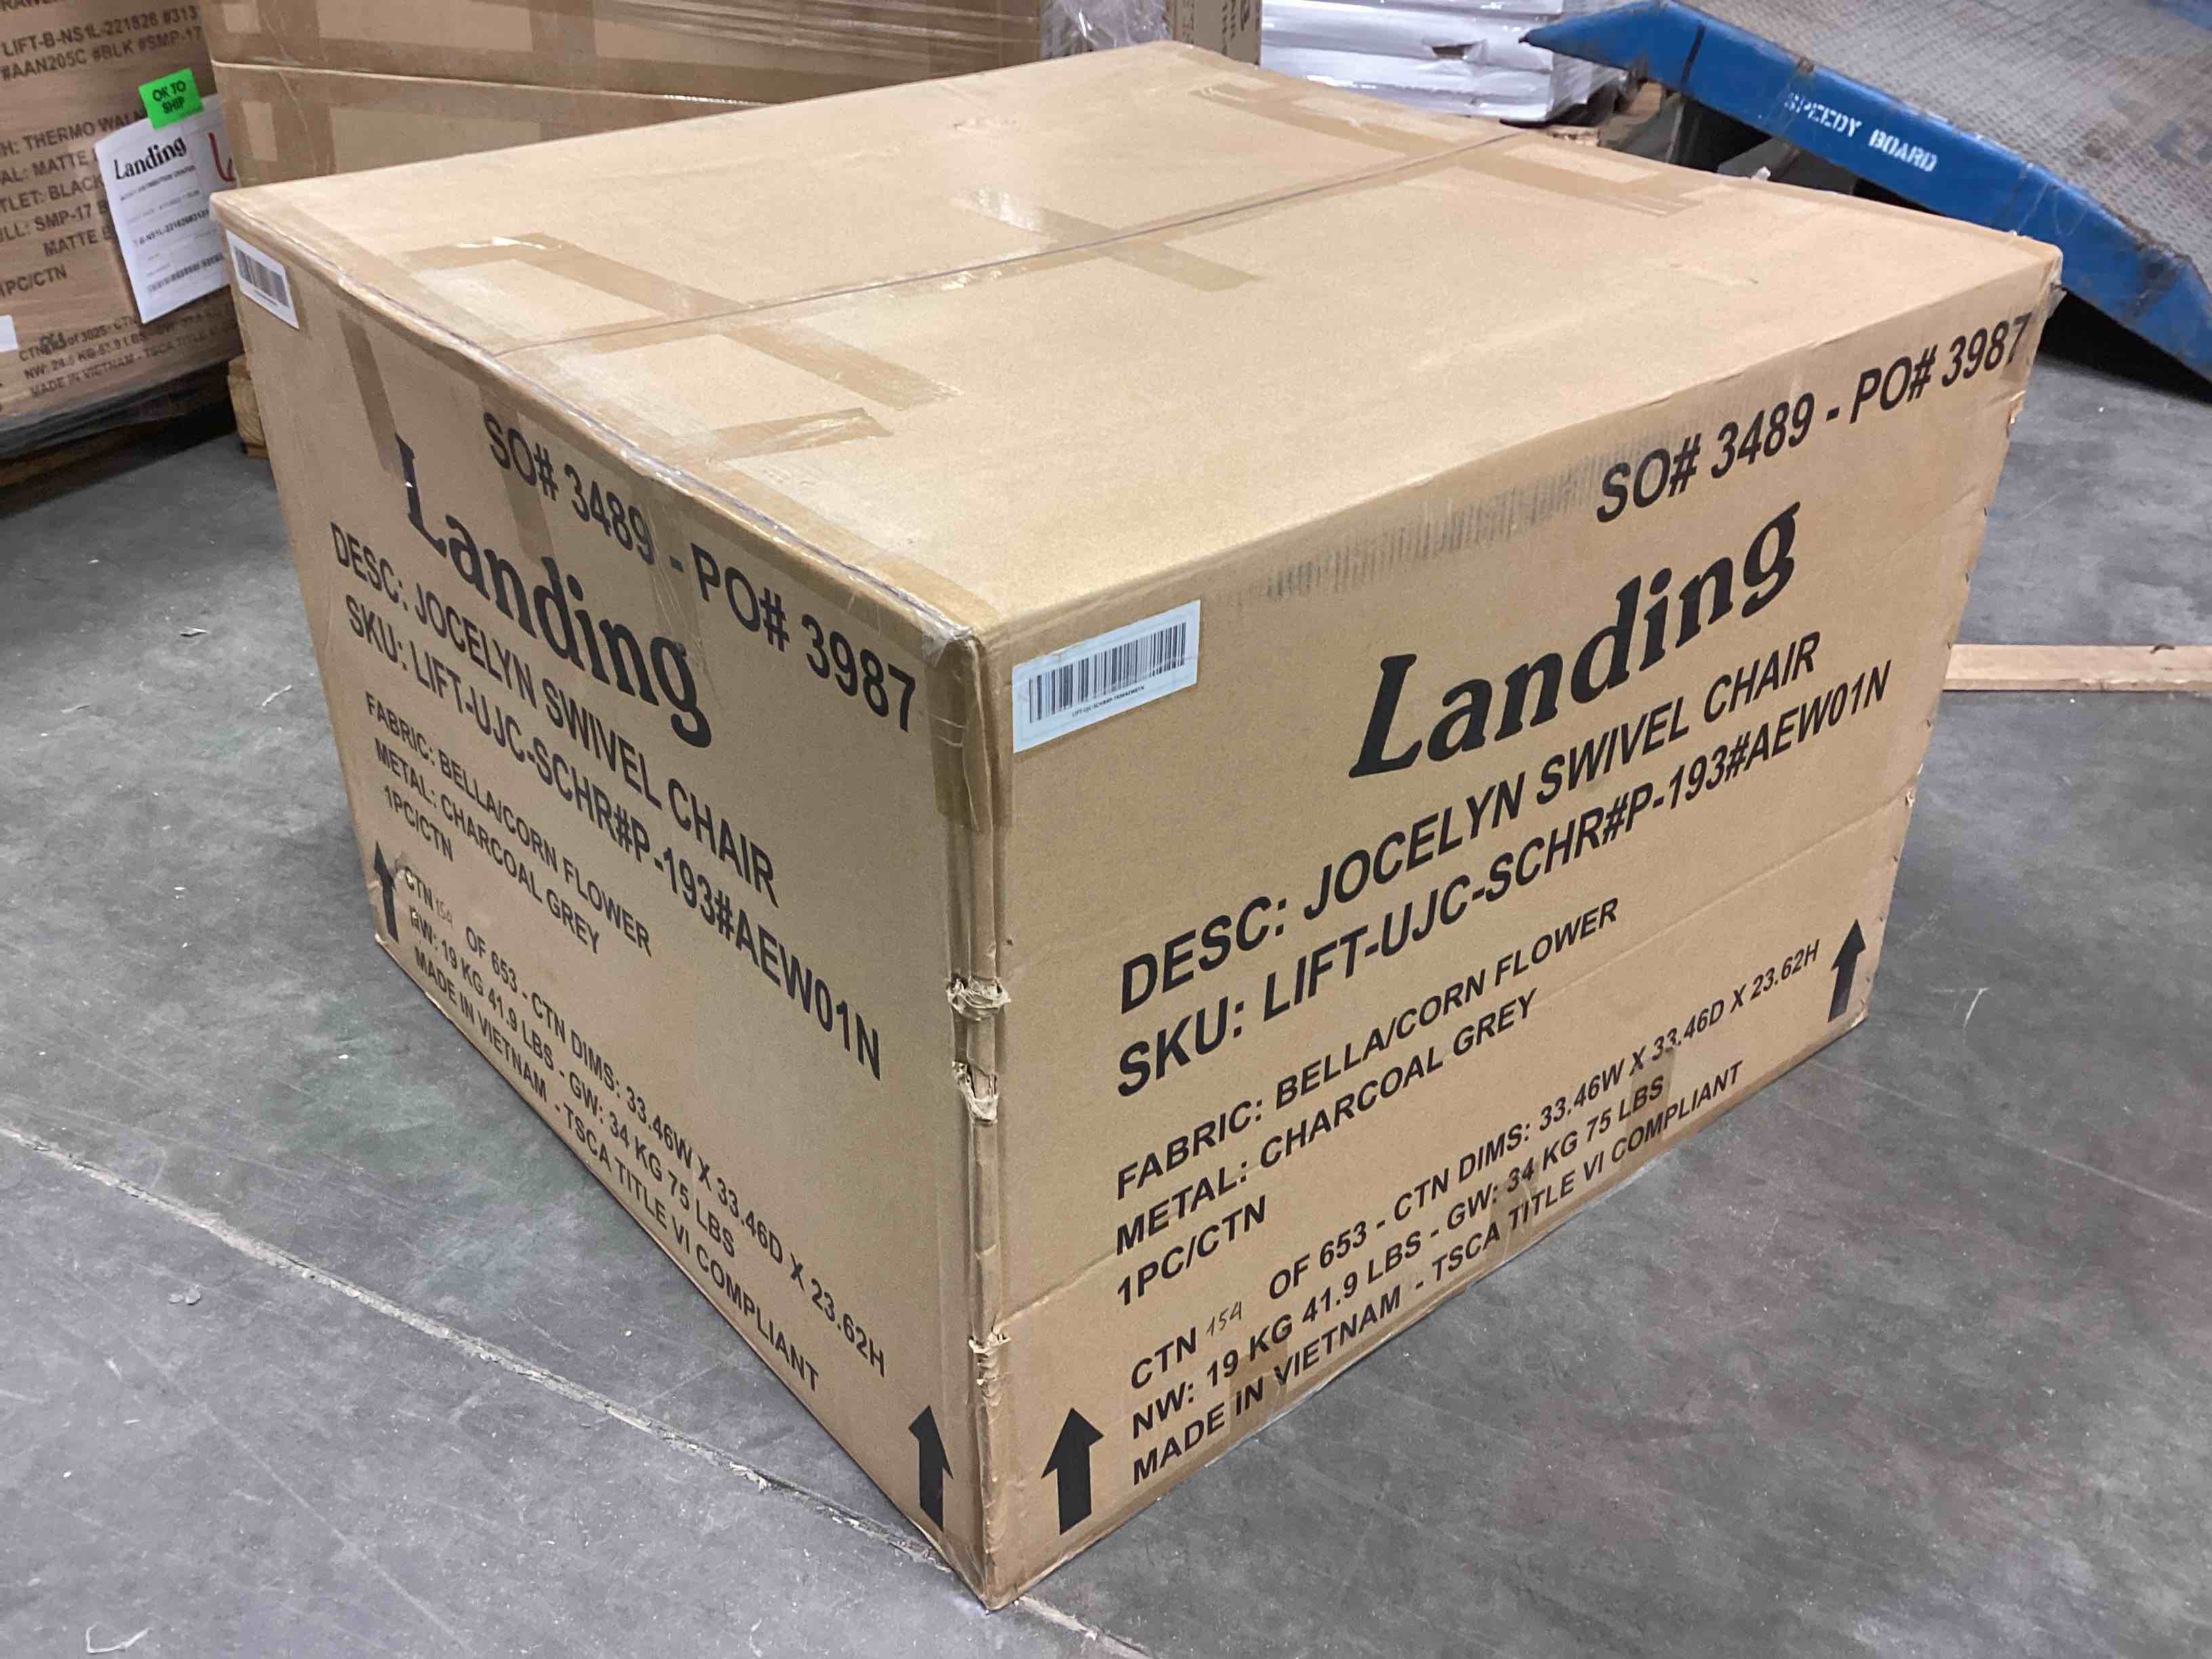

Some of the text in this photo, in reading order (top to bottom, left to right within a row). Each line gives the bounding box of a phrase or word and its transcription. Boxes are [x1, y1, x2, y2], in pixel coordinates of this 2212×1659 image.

[22, 121, 96, 150] THERMO
[33, 150, 89, 176] MATTE
[35, 203, 92, 231] SMP-17
[113, 136, 187, 180] Landing
[152, 79, 187, 102] OK TO
[162, 96, 186, 115] SHIP
[1784, 91, 1938, 172] SPEEDY BOARD
[43, 228, 98, 256] MATTE
[1597, 432, 1702, 523] SO#
[1711, 392, 1815, 479] 3489
[1849, 344, 1938, 424] PO#
[1941, 312, 2032, 388] 3987
[394, 432, 712, 748] Landing
[483, 411, 559, 501] SO#
[564, 464, 655, 565] 3489
[690, 542, 790, 653] PO#
[801, 614, 916, 733] 3987
[1348, 501, 1801, 779] Landing
[330, 521, 779, 909] DESC: JOCELYN SWIVEL CHAIR
[346, 594, 880, 1082] SKU: LIFT-UJC-SCHR#P-193#AEW01N
[365, 691, 652, 958] FABRIC: BELLA/CORN FLOWER
[374, 737, 600, 954] METAL: CHARCOAL GREY
[384, 785, 453, 863] 1PC/CTN
[1121, 631, 1820, 1015] DESC: JOCELYN SWIVEL CHAIR
[1118, 659, 1891, 1097] SKU: LIFT-UJC-SCHR#P-193#AEW01N
[405, 865, 434, 912] CTN
[466, 926, 486, 958] OF
[491, 950, 518, 994] 653
[531, 991, 566, 1044] CTN
[571, 1029, 621, 1099] DIMS:
[626, 1086, 693, 1169] 33.46W
[697, 1155, 712, 1192] X
[716, 1177, 783, 1264] 33.46D
[790, 1252, 805, 1291] X
[811, 1277, 885, 1378] 23.62H
[414, 946, 457, 1006] MADE
[459, 991, 474, 1025] IN
[478, 1011, 547, 1102] VIETNAM
[563, 1102, 612, 1172] TSCA
[615, 1156, 668, 1230] TITLE
[672, 1215, 690, 1254] VI
[696, 1244, 819, 1392] COMPLIANT
[441, 939, 457, 970] 19
[461, 958, 484, 997] KG
[488, 988, 518, 1032] 41.9
[521, 1020, 554, 1071] LBS
[569, 1071, 604, 1124] GW:
[609, 1111, 630, 1150] 34
[634, 1136, 662, 1182] KG
[668, 1170, 690, 1211] 75
[696, 1197, 735, 1258] LBS
[1116, 987, 1538, 1256] METAL: CHARCOAL GREY
[1118, 897, 1618, 1201] FABRIC: BELLA/CORN FLOWER
[1131, 1326, 1196, 1389] CTN
[1206, 1300, 1242, 1336] 154
[1269, 1253, 1311, 1300] OF
[1319, 1221, 1367, 1269] 653
[1394, 1167, 1450, 1221] CTN
[1458, 1123, 1530, 1184] DIMS:
[1539, 1058, 1625, 1131] 33.46W
[1629, 1045, 1646, 1077] X
[1652, 999, 1725, 1062] 33.46D
[1729, 983, 1747, 1013] X
[1750, 939, 1820, 1001] 23.62H
[1117, 1194, 1266, 1306] 1PC/CTN
[1132, 1381, 1194, 1440] NW:
[1206, 1349, 1239, 1387] 19
[1249, 1313, 1292, 1362] KG
[1302, 1271, 1358, 1324] 41.9
[1368, 1230, 1421, 1285] LBS
[1447, 1183, 1498, 1230] GW:
[1507, 1157, 1535, 1193] 34
[1542, 1130, 1578, 1172] KG
[1586, 1107, 1612, 1142] 75
[1618, 1074, 1664, 1122] LBS
[1134, 1401, 1225, 1486] MADE
[1235, 1376, 1263, 1416] IN
[1273, 1284, 1401, 1386] VIETNAM
[1431, 1221, 1500, 1282] TSCA
[1508, 1170, 1576, 1231] TITLE
[1583, 1151, 1604, 1181] VI
[1612, 1060, 1743, 1163] COMPLIANT
